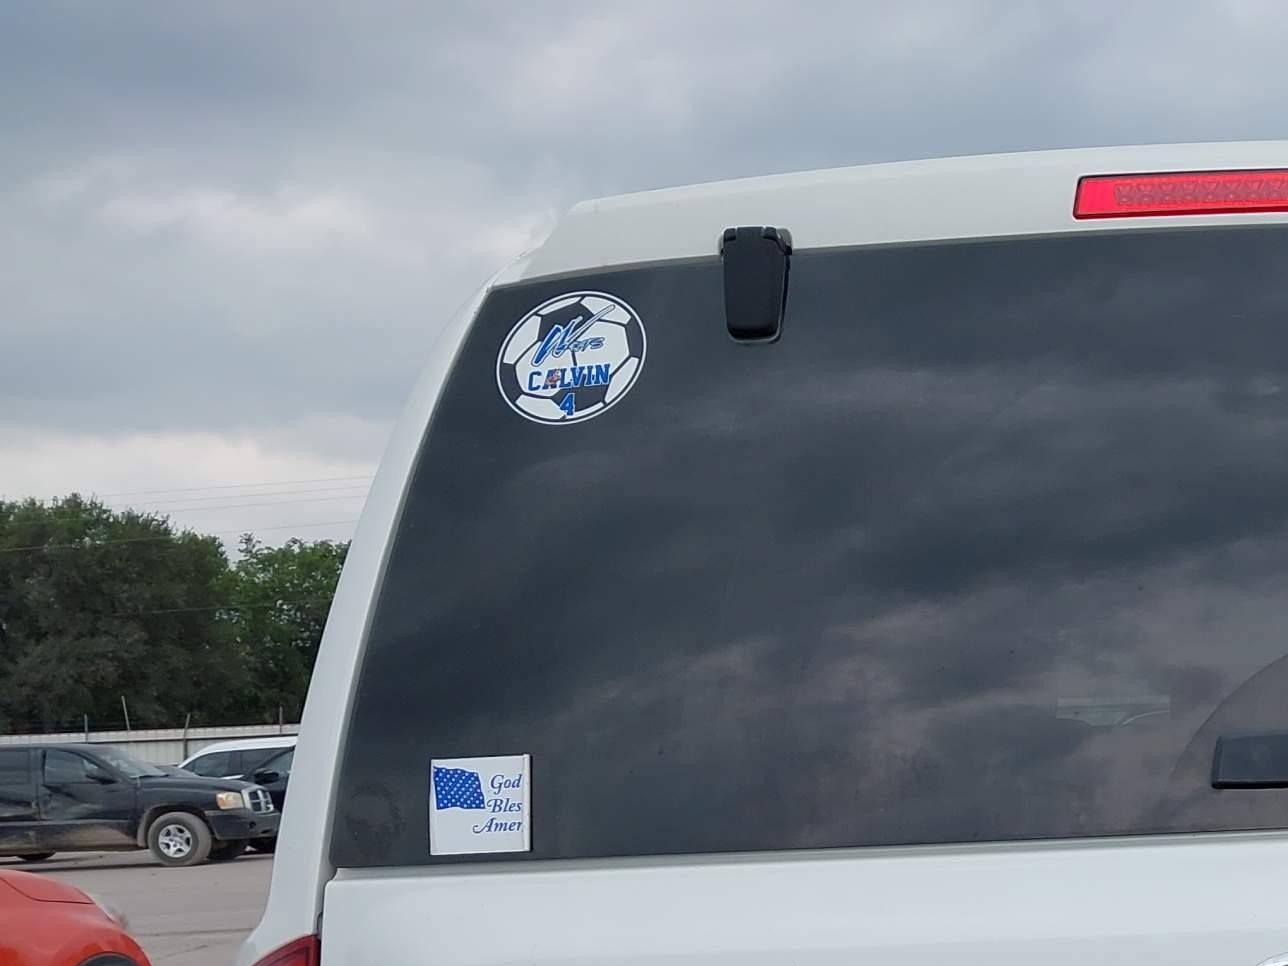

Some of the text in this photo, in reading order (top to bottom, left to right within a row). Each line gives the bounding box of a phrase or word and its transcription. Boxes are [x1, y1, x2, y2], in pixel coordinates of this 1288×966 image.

[527, 363, 611, 391] CALVIN
[559, 393, 576, 417] 4
[490, 774, 523, 795] God
[486, 798, 523, 813] Bles
